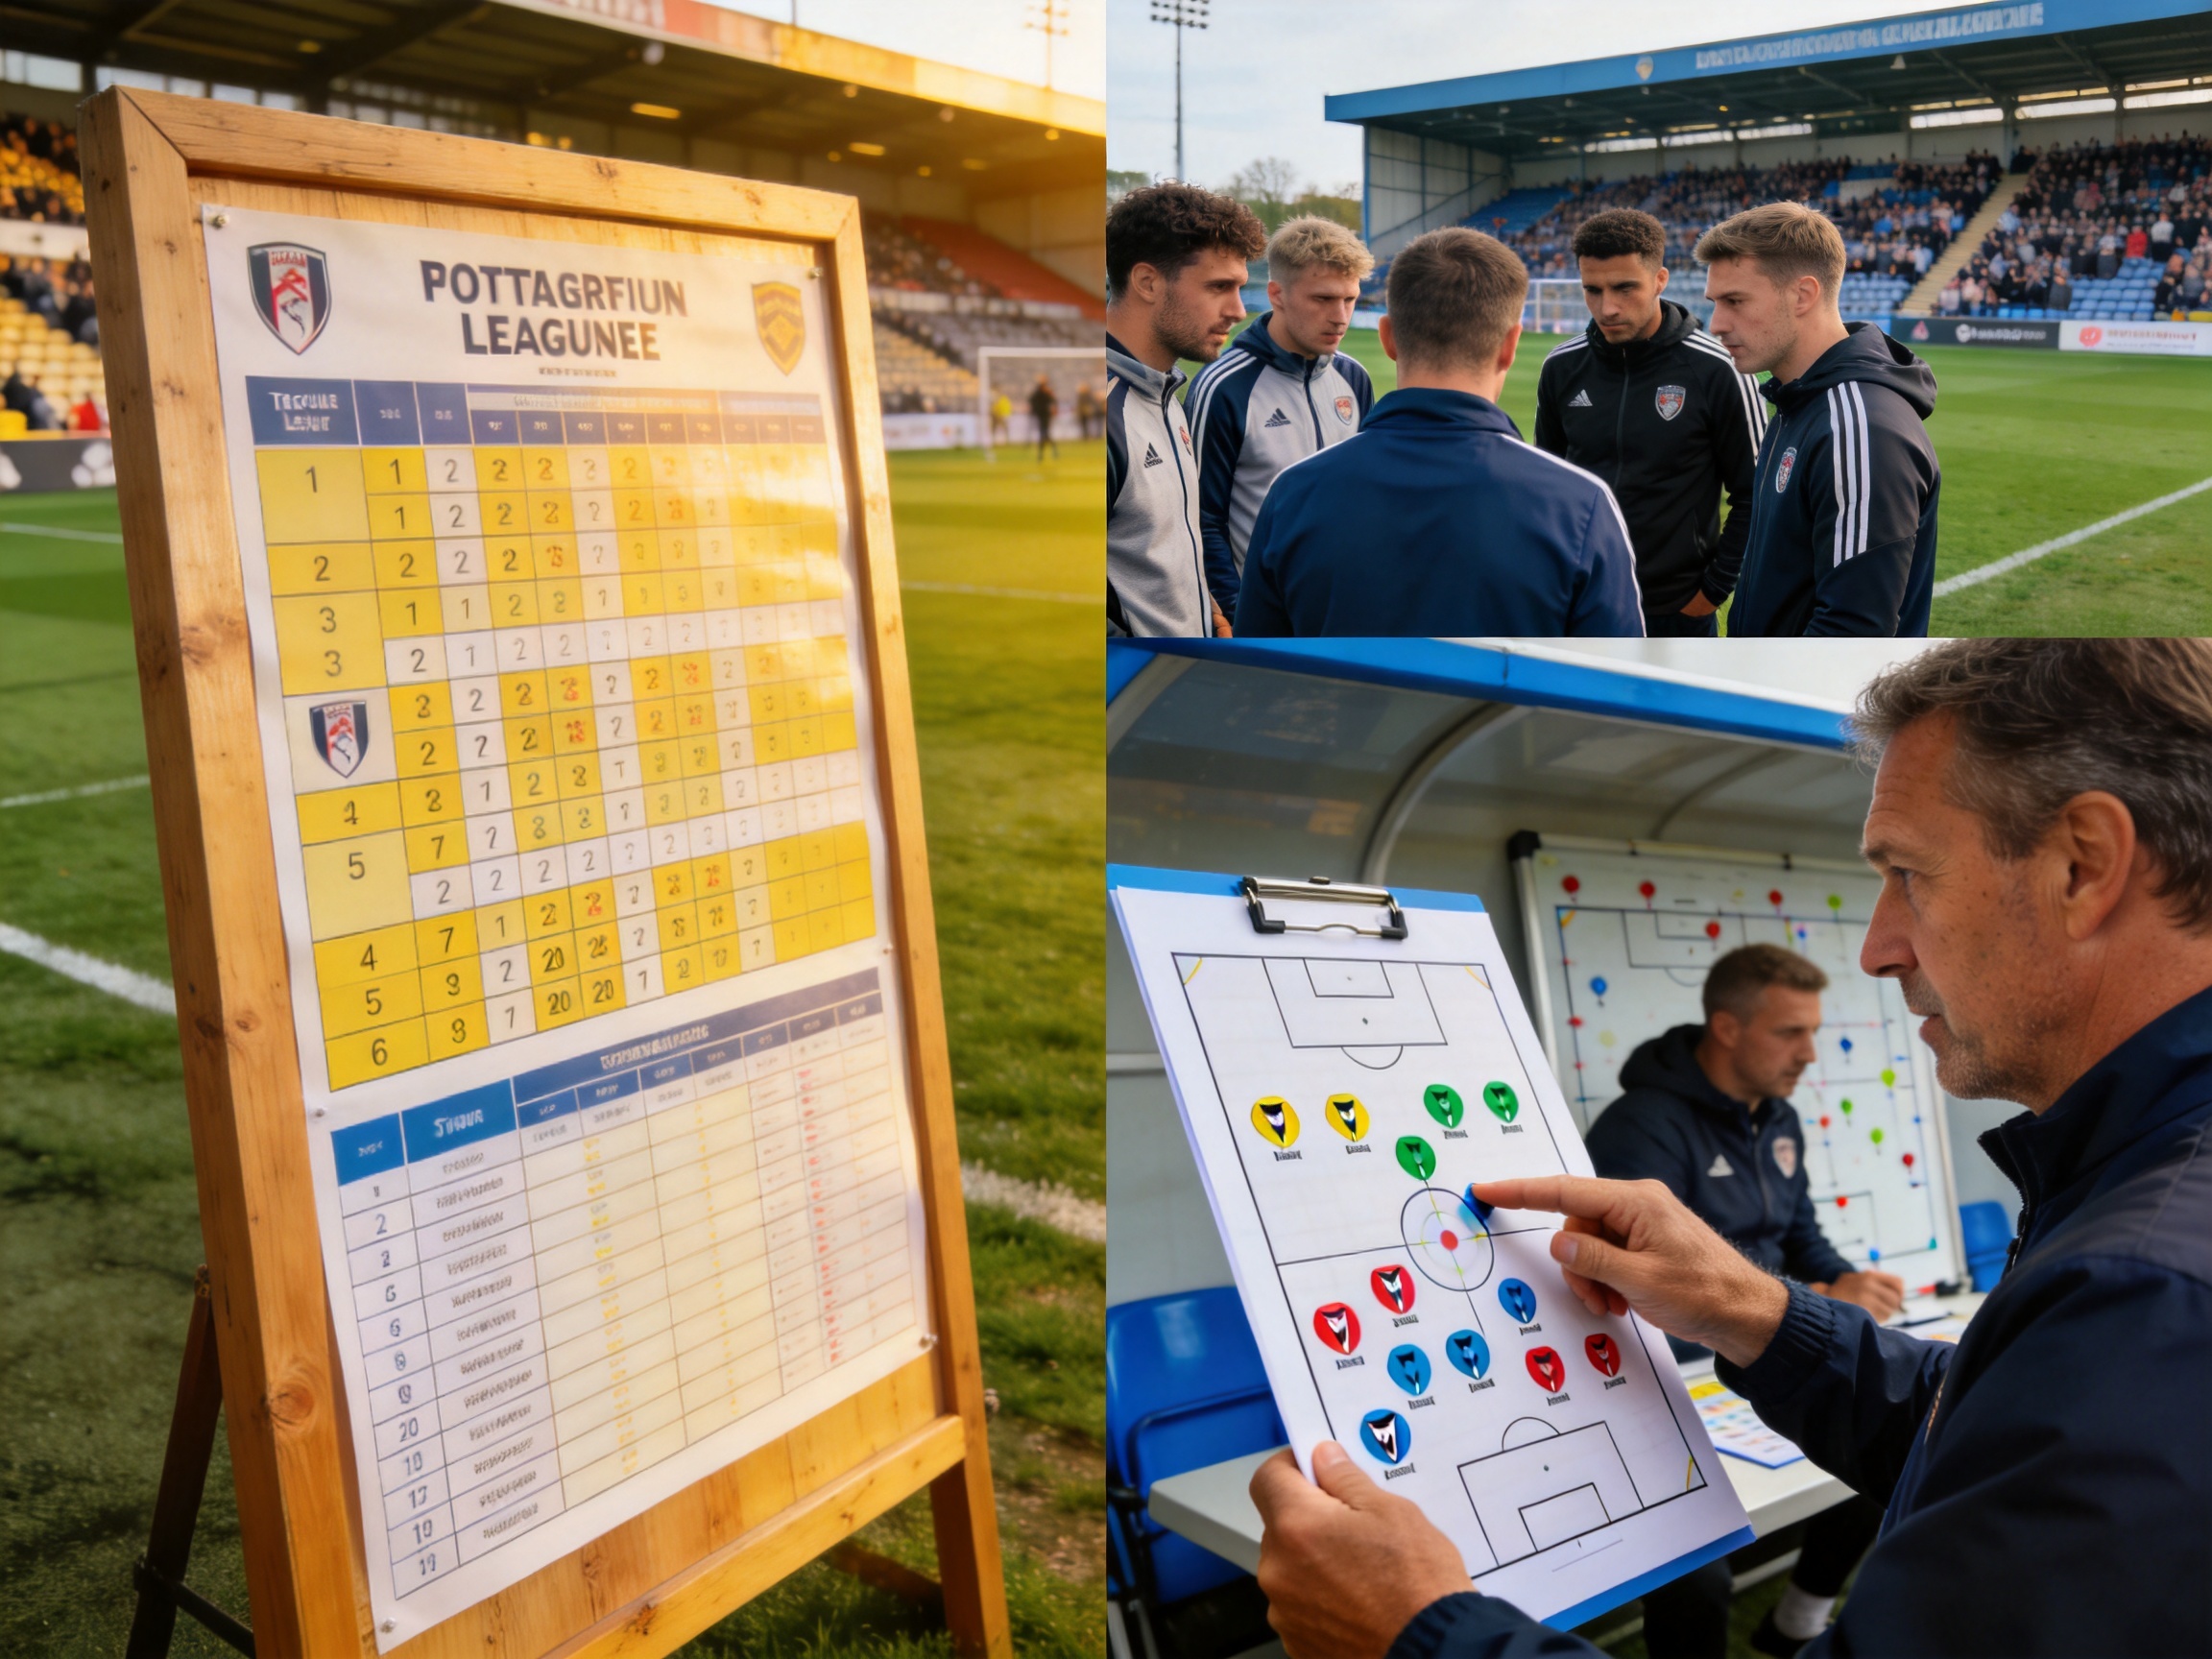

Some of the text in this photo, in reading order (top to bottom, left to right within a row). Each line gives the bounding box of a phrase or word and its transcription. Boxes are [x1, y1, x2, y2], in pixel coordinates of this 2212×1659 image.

[420, 260, 688, 318] POTTAGRFIUN
[461, 312, 661, 361] LEAGUNEE
[305, 466, 318, 493] 1
[390, 459, 400, 484] 1
[445, 459, 458, 482] 2
[395, 507, 405, 529] 1
[449, 505, 465, 527] 2
[314, 556, 330, 581] 2
[399, 553, 418, 577] 2
[455, 551, 470, 573] 2
[503, 549, 518, 571] 2
[320, 607, 337, 633] 3
[406, 602, 417, 625] 1
[462, 598, 469, 619] 1
[509, 594, 522, 616] 2
[325, 651, 342, 677] 3
[411, 649, 426, 672] 2
[466, 645, 475, 666] 1
[514, 638, 526, 661] 2
[560, 635, 571, 656] 2
[469, 689, 483, 711] 2
[421, 742, 437, 765] 2
[527, 773, 541, 796] 2
[349, 853, 365, 879] 5
[437, 880, 450, 904] 2
[491, 870, 502, 891] 2
[538, 860, 550, 883] 2
[583, 851, 593, 871] 2
[360, 944, 377, 971] 4
[439, 927, 454, 952] 7
[366, 988, 382, 1016] 5
[501, 960, 514, 982] 2
[543, 948, 565, 973] 20
[372, 1039, 388, 1066] 6
[547, 990, 571, 1016] 20
[376, 1214, 387, 1235] 2
[398, 1418, 419, 1442] 20
